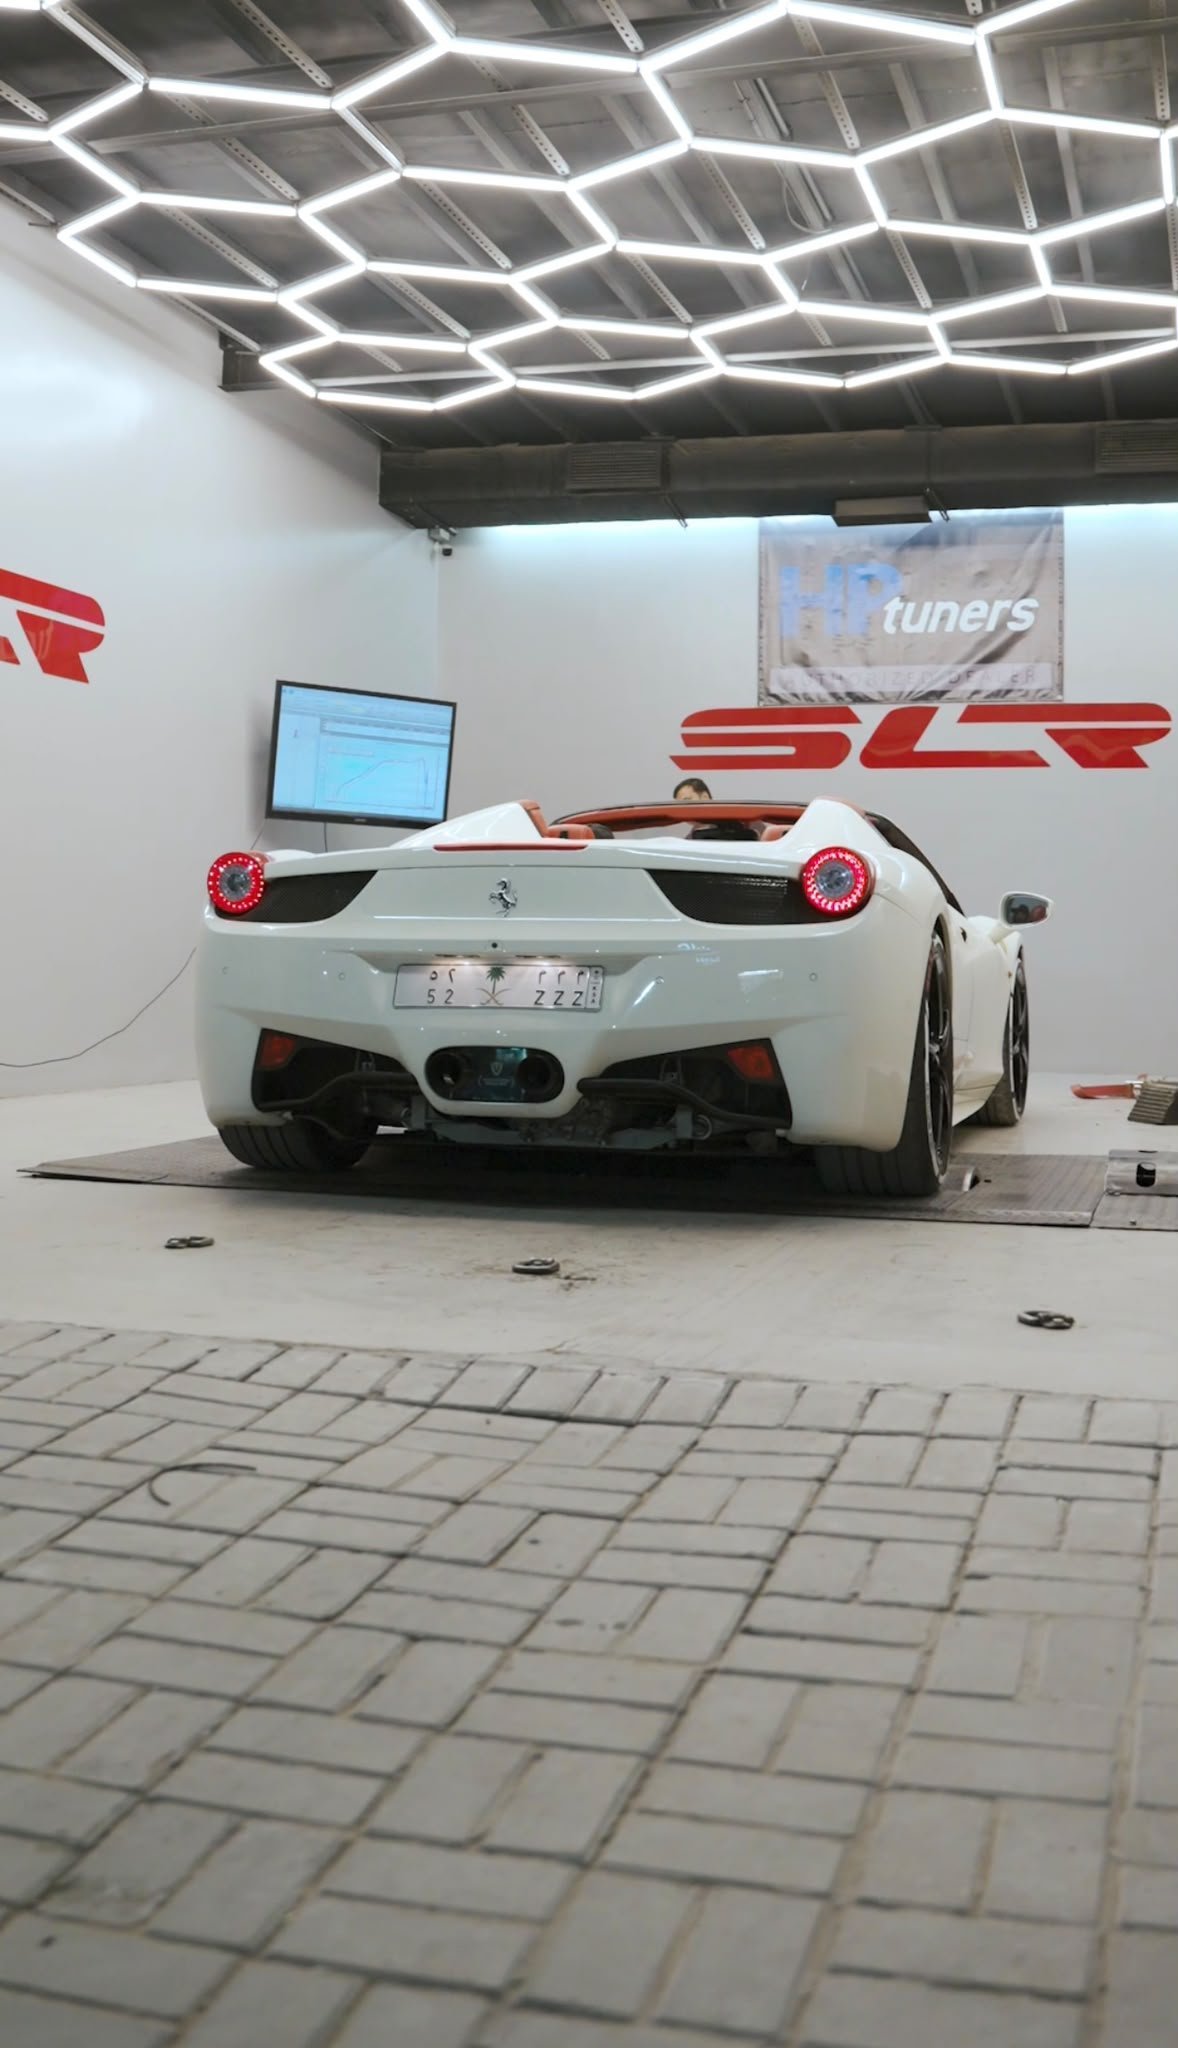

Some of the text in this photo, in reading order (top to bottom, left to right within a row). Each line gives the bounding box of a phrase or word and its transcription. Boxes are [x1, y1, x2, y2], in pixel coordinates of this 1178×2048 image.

[780, 563, 1039, 639] HP tuners
[669, 702, 1172, 770] SLR
